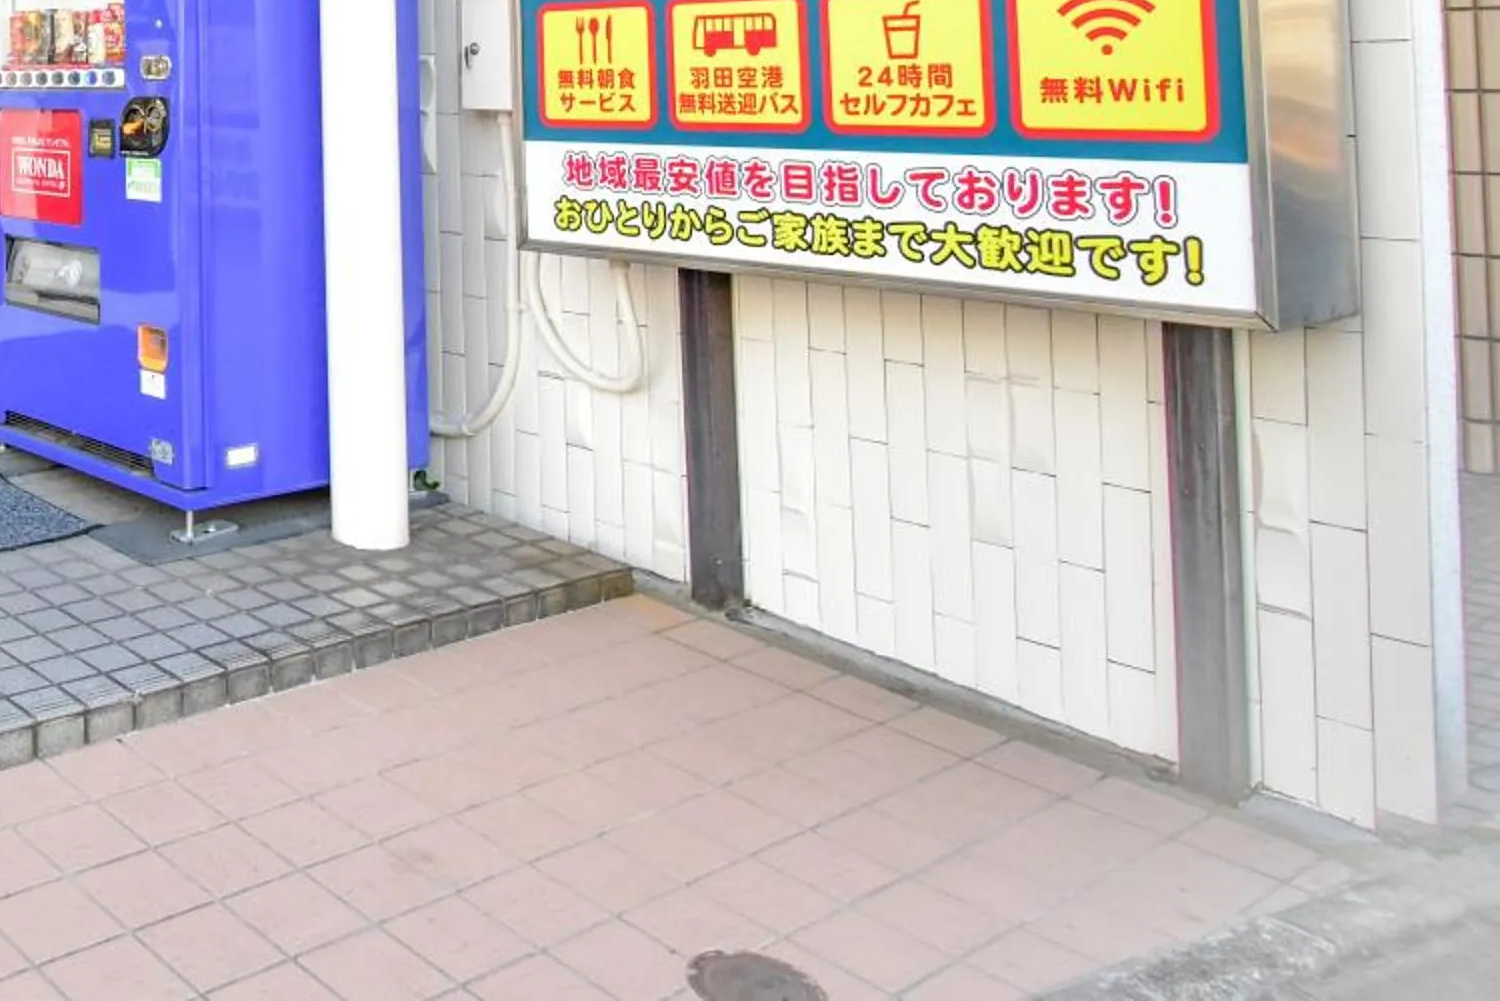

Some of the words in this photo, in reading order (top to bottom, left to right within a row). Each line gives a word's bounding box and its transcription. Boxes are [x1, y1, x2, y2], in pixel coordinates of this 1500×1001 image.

[557, 68, 636, 90] 無料朝食
[690, 65, 784, 90] 羽田空港
[857, 63, 954, 89] 24時間
[1039, 76, 1185, 104] 無料Wifi
[560, 92, 637, 113] サービス
[678, 92, 800, 116] 無料送迎バス
[840, 93, 977, 117] セルフカフェ
[17, 156, 65, 180] WONDA
